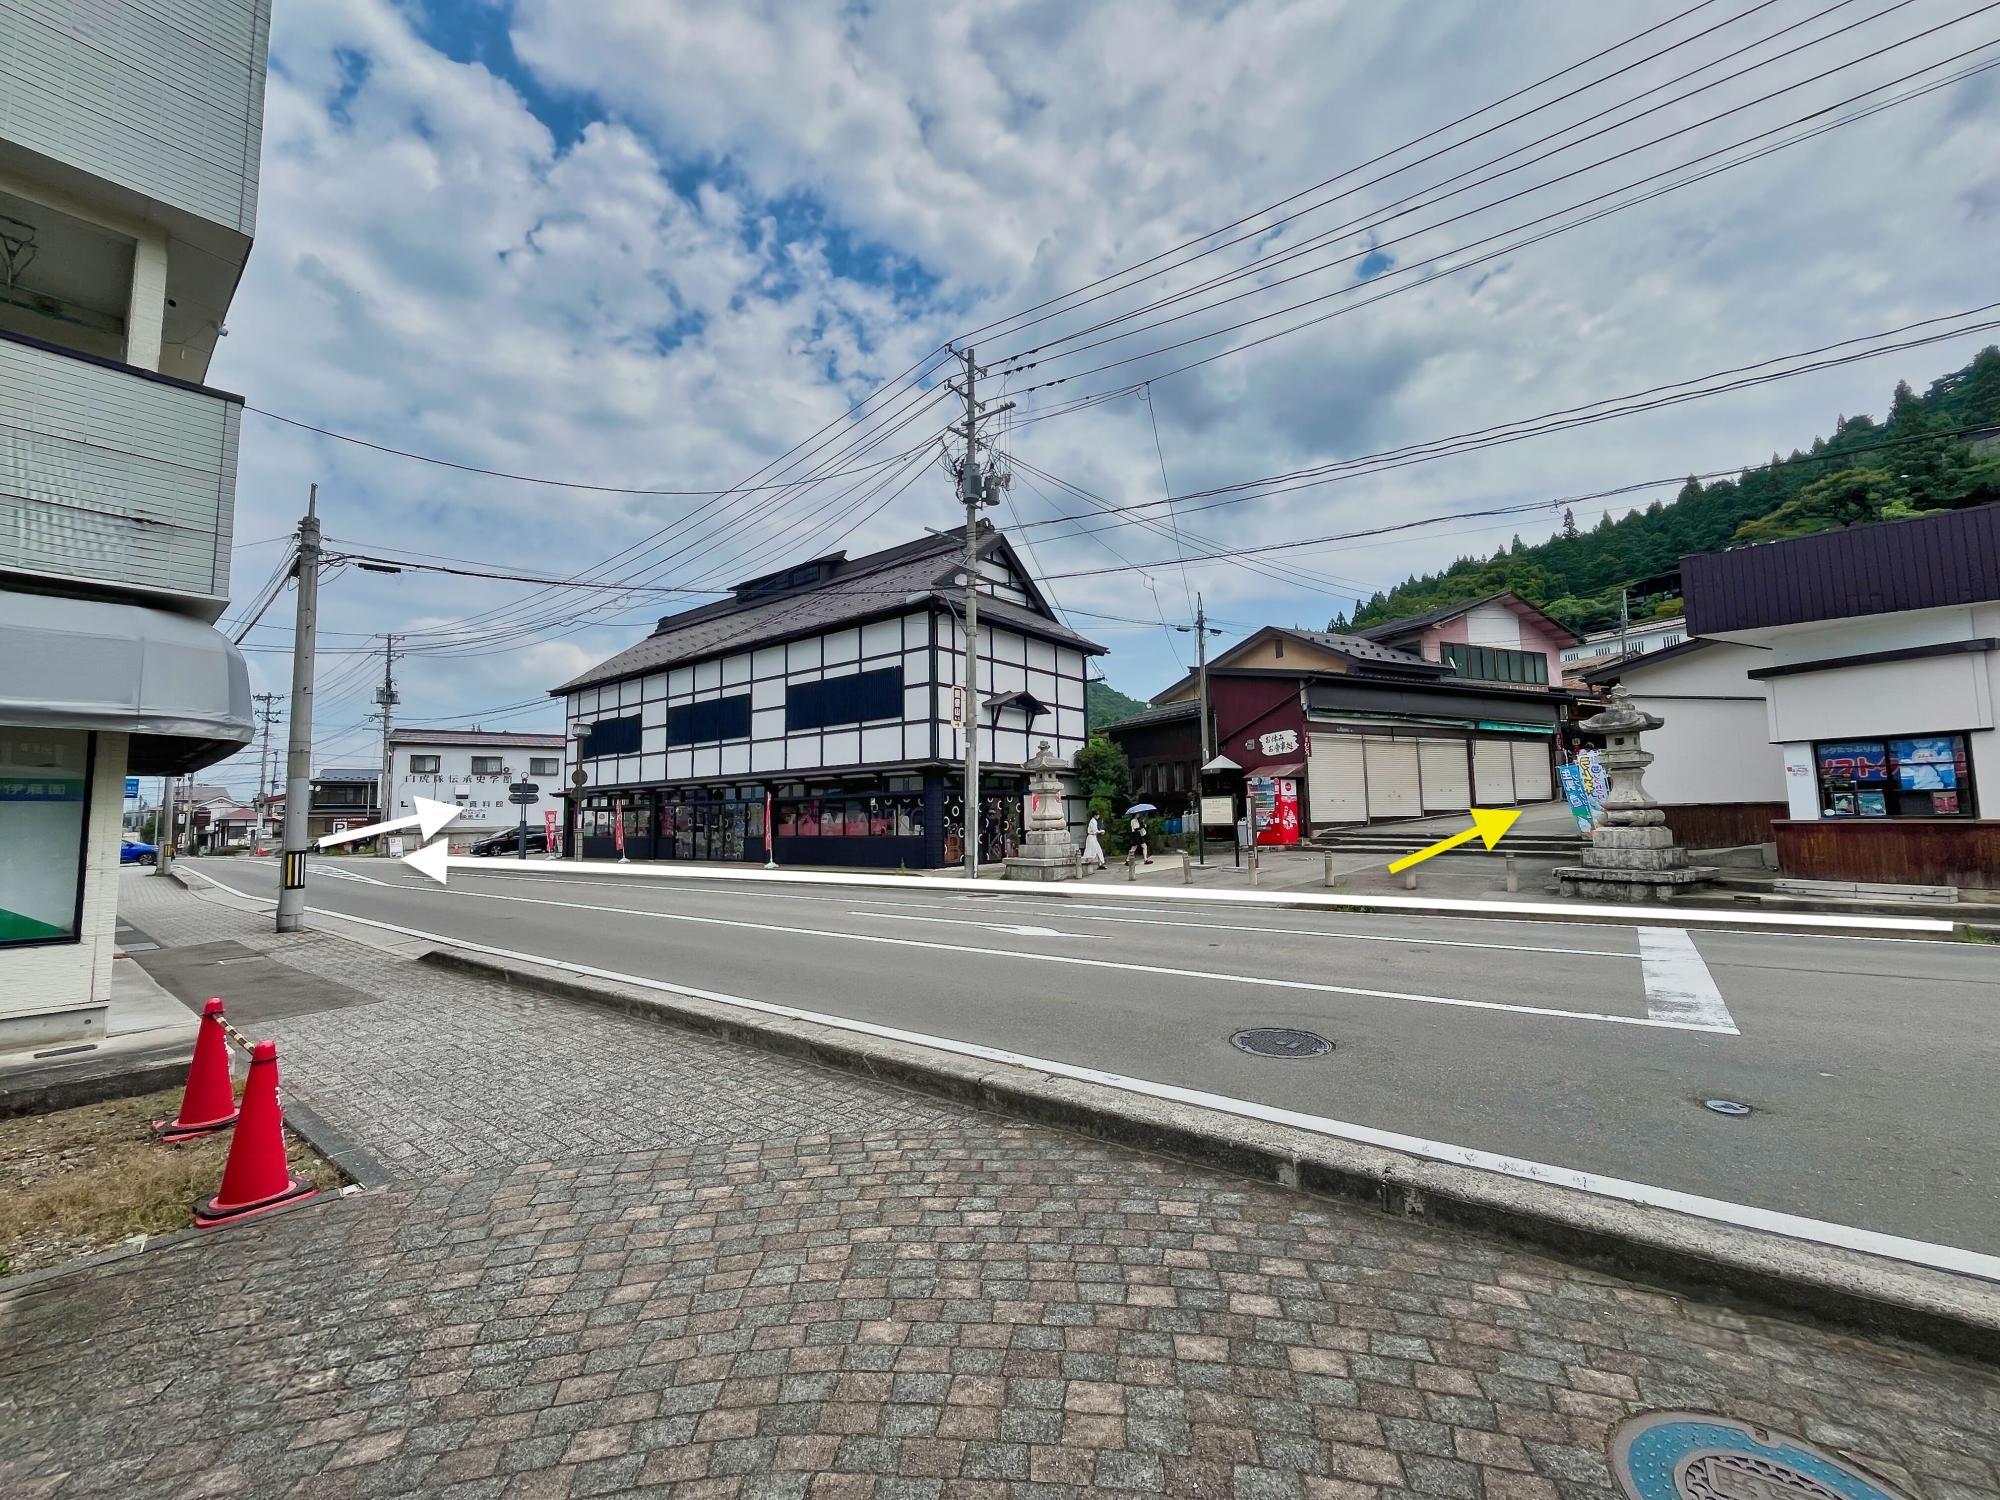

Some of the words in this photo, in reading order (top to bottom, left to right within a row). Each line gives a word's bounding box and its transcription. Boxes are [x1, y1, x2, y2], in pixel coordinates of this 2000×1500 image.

[405, 774, 513, 784] 白虎隊伝承史学館
